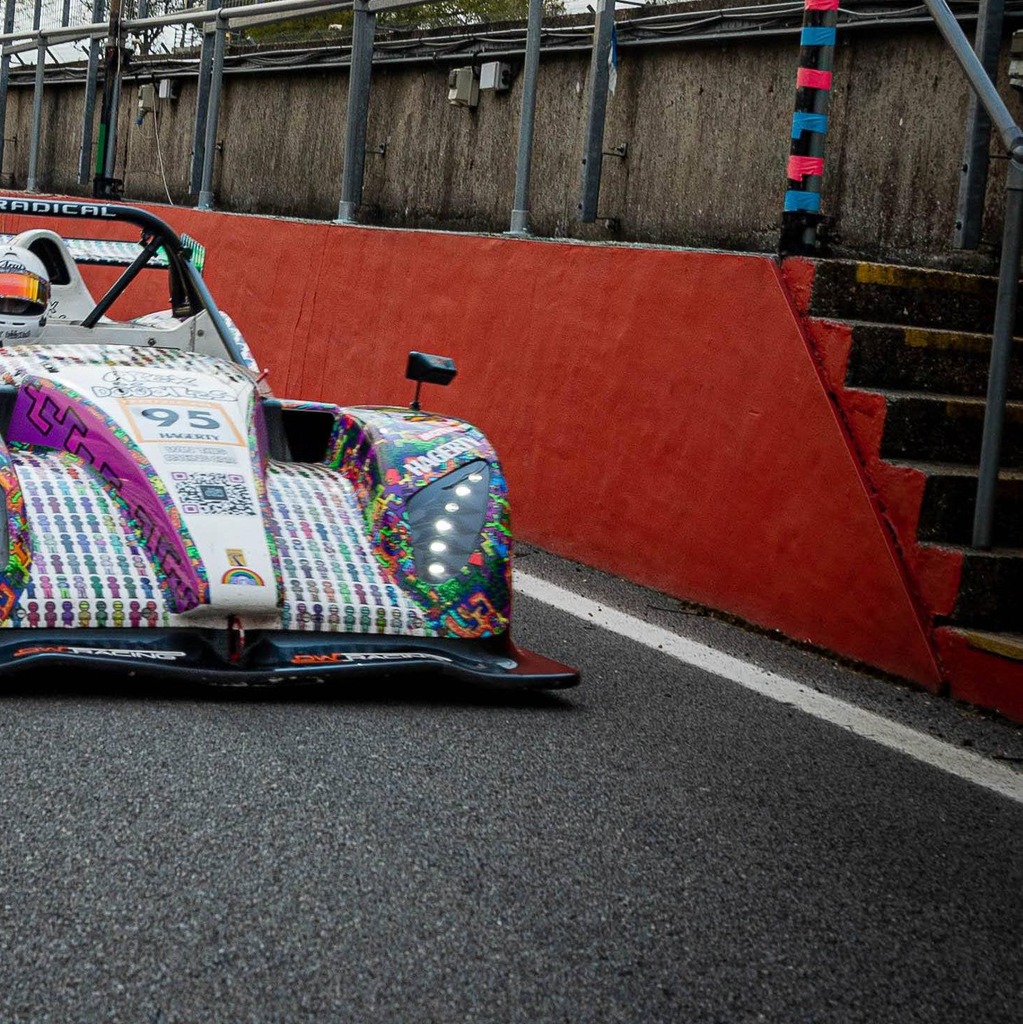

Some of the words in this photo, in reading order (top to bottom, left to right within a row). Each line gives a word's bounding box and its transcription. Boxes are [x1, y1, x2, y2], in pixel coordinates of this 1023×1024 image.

[141, 407, 221, 430] 95
[159, 432, 219, 441] HAGERTY
[403, 437, 482, 476] HAGERTY
